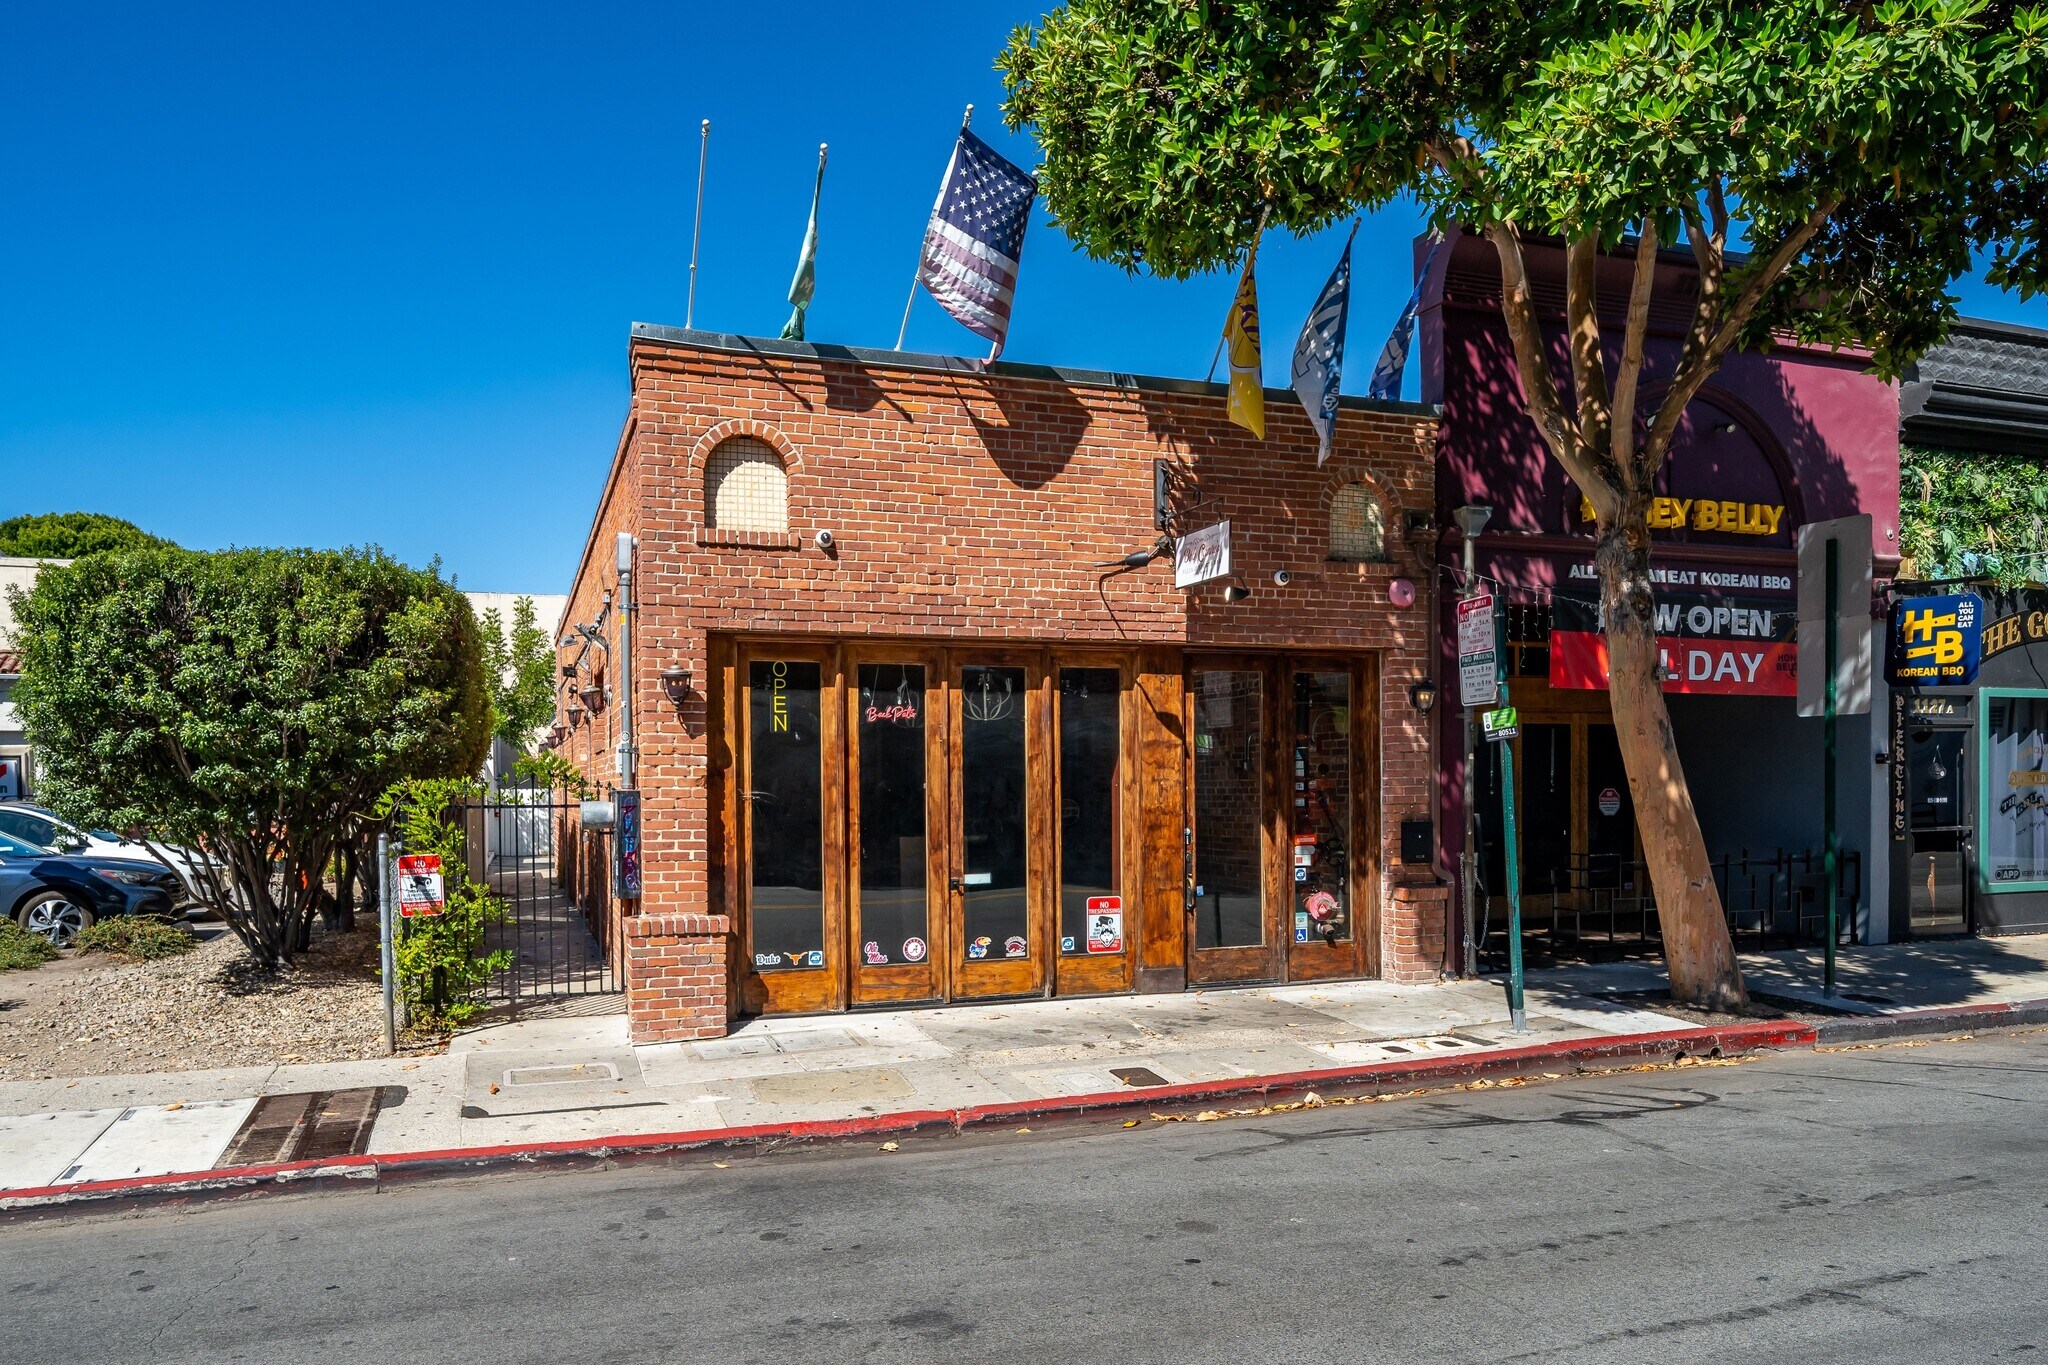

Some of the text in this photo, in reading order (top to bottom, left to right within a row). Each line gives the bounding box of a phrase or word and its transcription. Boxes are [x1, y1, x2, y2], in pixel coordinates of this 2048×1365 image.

[1694, 500, 1784, 534] BELLY
[1570, 565, 1598, 579] ALL
[1667, 570, 1697, 585] EAT
[1701, 572, 1758, 588] KOREAN
[1762, 575, 1791, 590] BBQ
[1463, 600, 1487, 611] TOW-AWAY
[1460, 609, 1490, 622] NO PARKING
[1687, 605, 1771, 637] OPEN
[2028, 611, 2048, 639] G
[1462, 655, 1473, 664] PAID
[1473, 651, 1493, 662] PARKING
[1688, 650, 1764, 682] DAY
[1897, 666, 1964, 677] KOREAN BBQ
[772, 661, 787, 732] OPEN
[1498, 727, 1516, 737] 80511
[1895, 694, 1905, 829] PIERCING
[414, 860, 426, 868] NO
[2002, 870, 2019, 879] APP
[756, 954, 780, 965] Duke
[868, 952, 888, 963] Miss
